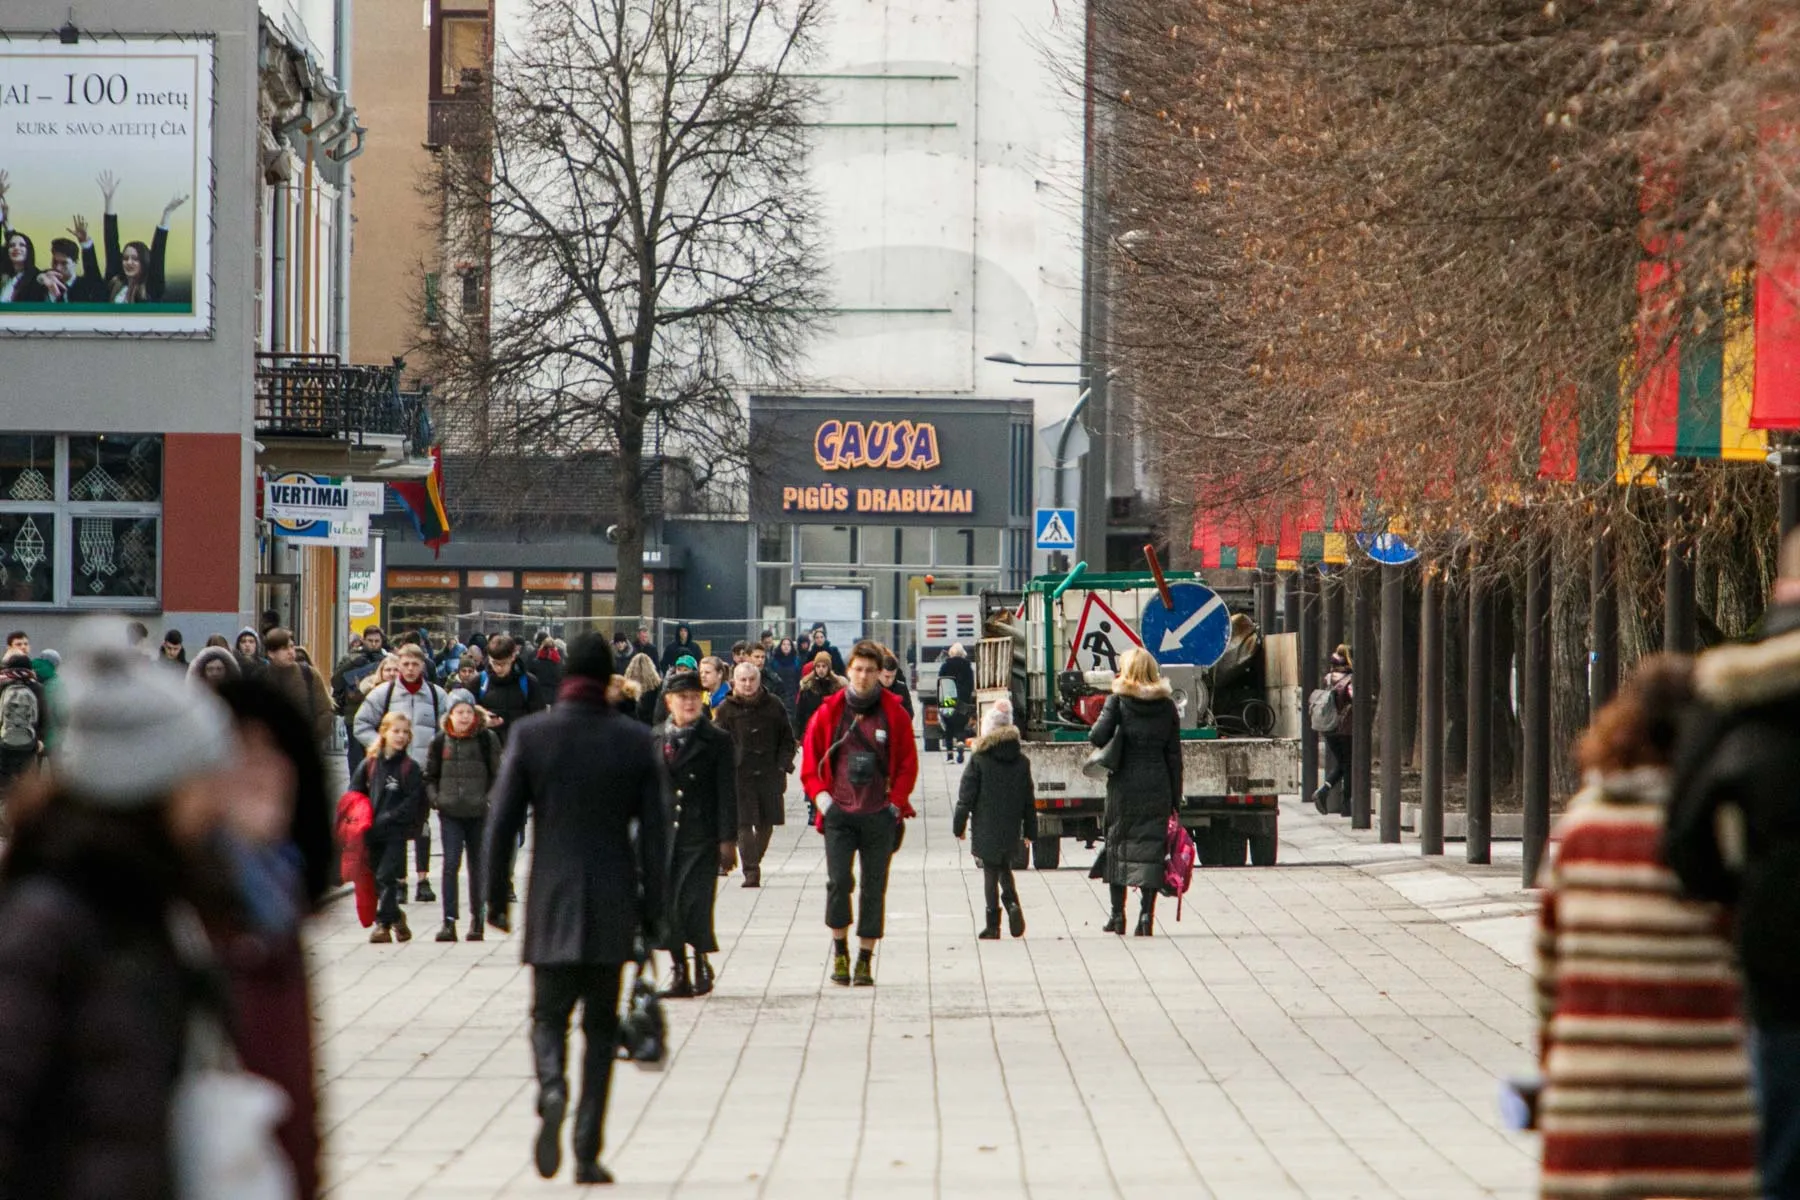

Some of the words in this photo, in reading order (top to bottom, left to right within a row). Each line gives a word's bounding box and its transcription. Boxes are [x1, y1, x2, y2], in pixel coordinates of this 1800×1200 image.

[64, 73, 128, 105] 100
[137, 90, 188, 110] metų
[16, 122, 57, 136] KURK
[66, 122, 104, 136] SAVO
[108, 122, 156, 139] ATEITĮ
[160, 120, 187, 136] ČIA
[814, 419, 941, 471] GAUSA
[271, 485, 348, 507] VERTIMAI
[783, 483, 849, 511] PIGŪS
[856, 484, 974, 513] DRABUŽIAI
